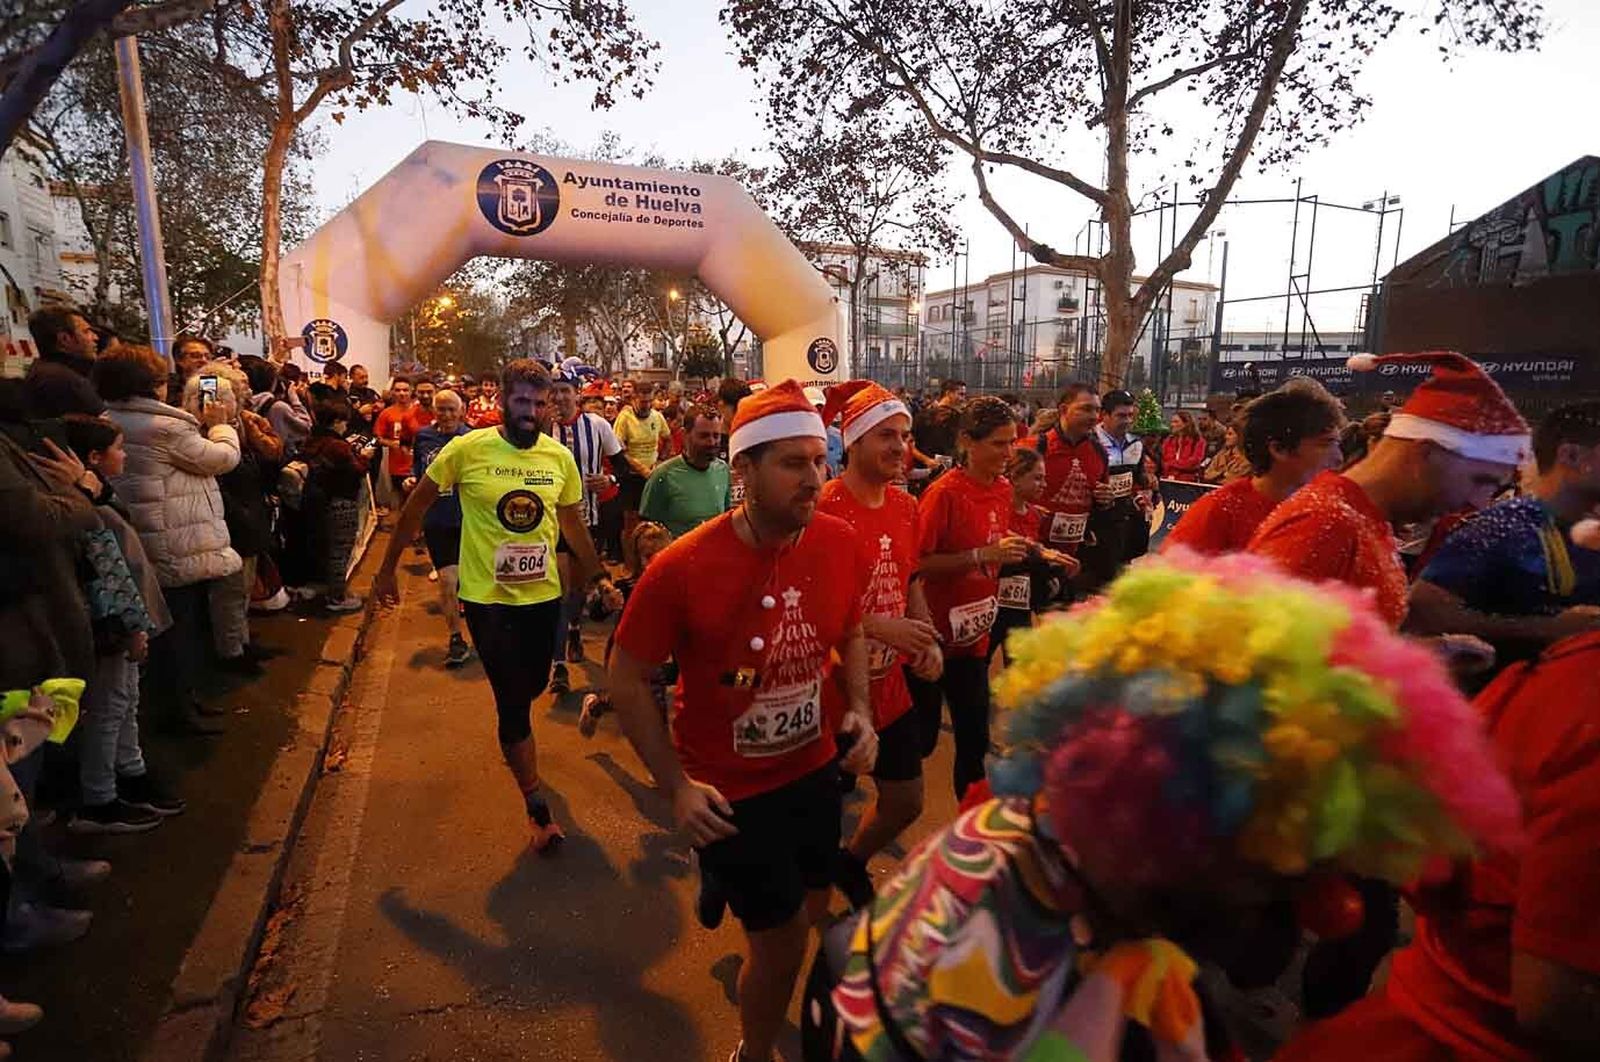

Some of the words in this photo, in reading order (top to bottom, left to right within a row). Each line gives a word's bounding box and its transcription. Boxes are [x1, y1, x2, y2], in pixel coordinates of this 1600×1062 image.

[563, 172, 701, 197] Ayuntamiento
[605, 192, 629, 207] de
[636, 194, 701, 214] Huelva
[571, 208, 633, 223] Concejalía
[636, 213, 650, 224] de
[654, 215, 704, 229] Deportes
[1502, 361, 1574, 372] HYUNDAI
[1167, 500, 1190, 513] Ayu
[519, 554, 544, 572] 604
[774, 701, 815, 736] 248
